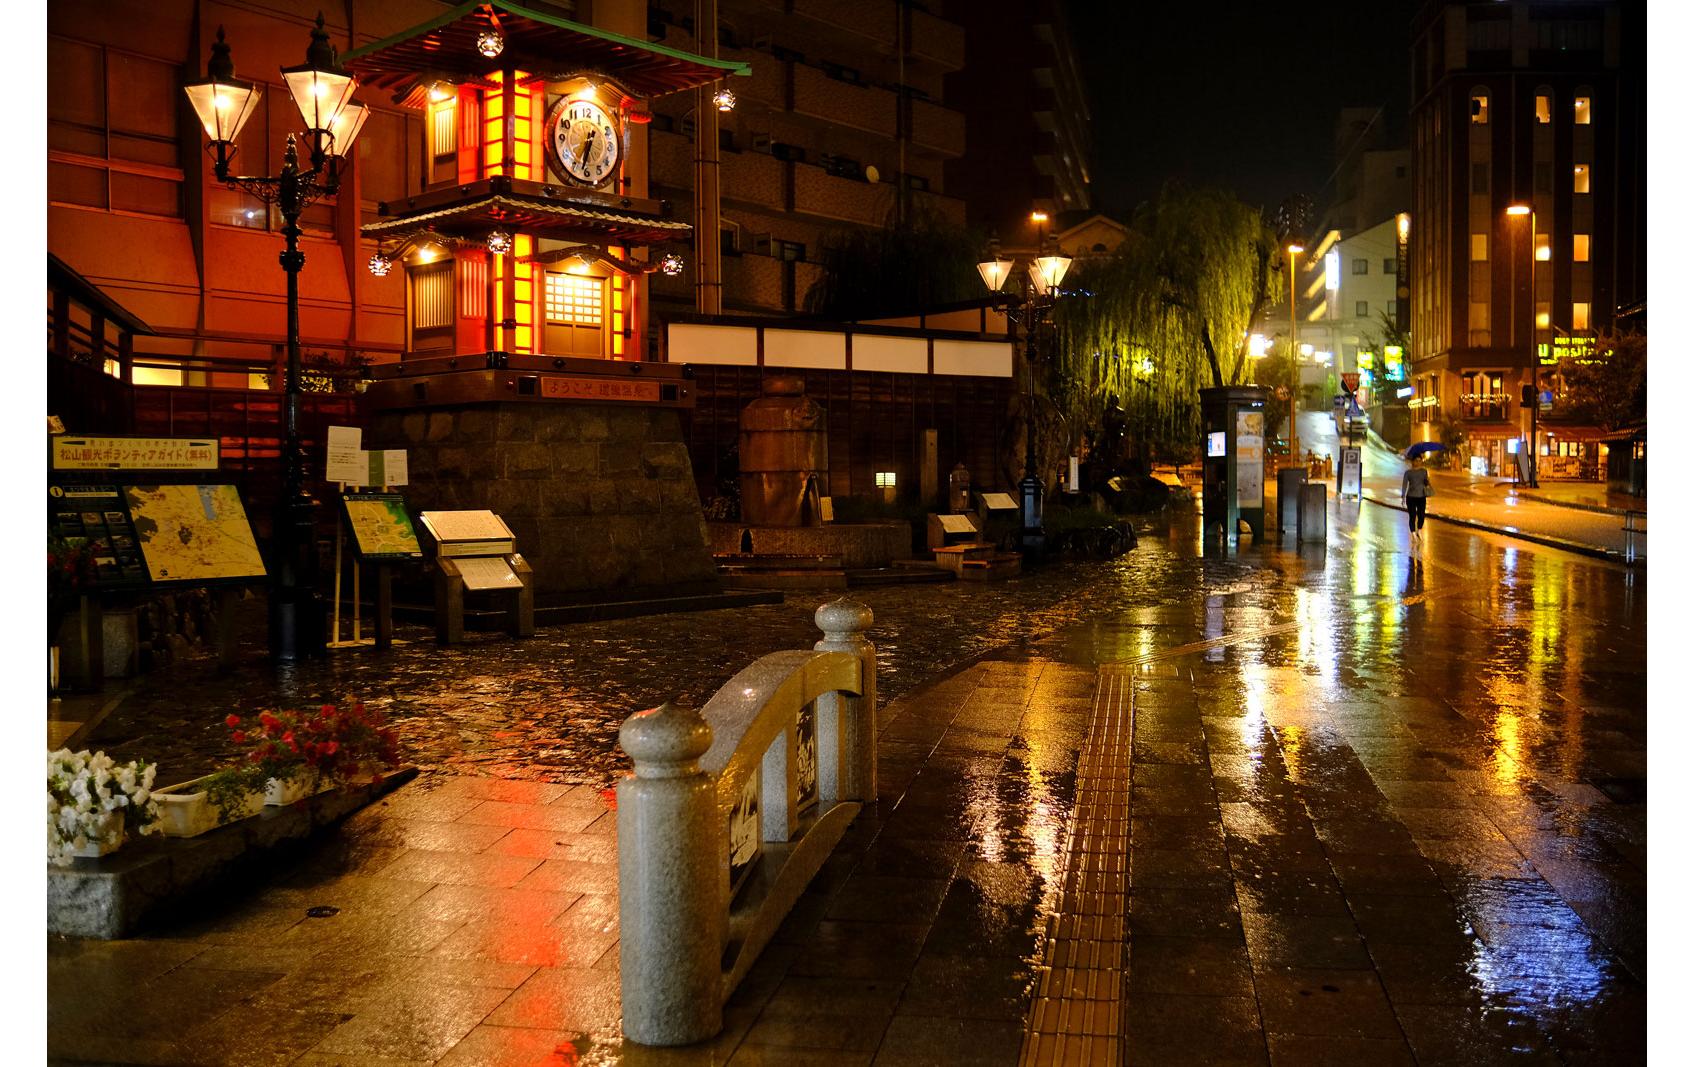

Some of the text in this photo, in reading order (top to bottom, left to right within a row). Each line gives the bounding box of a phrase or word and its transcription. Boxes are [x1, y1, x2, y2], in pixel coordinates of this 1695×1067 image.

[569, 109, 577, 120] 11
[582, 108, 591, 119] 12
[560, 118, 570, 130] 10
[597, 114, 601, 126] 1
[558, 133, 565, 143] 9
[583, 167, 589, 177] 6
[596, 165, 602, 175] 5
[550, 382, 592, 395] ようこそ
